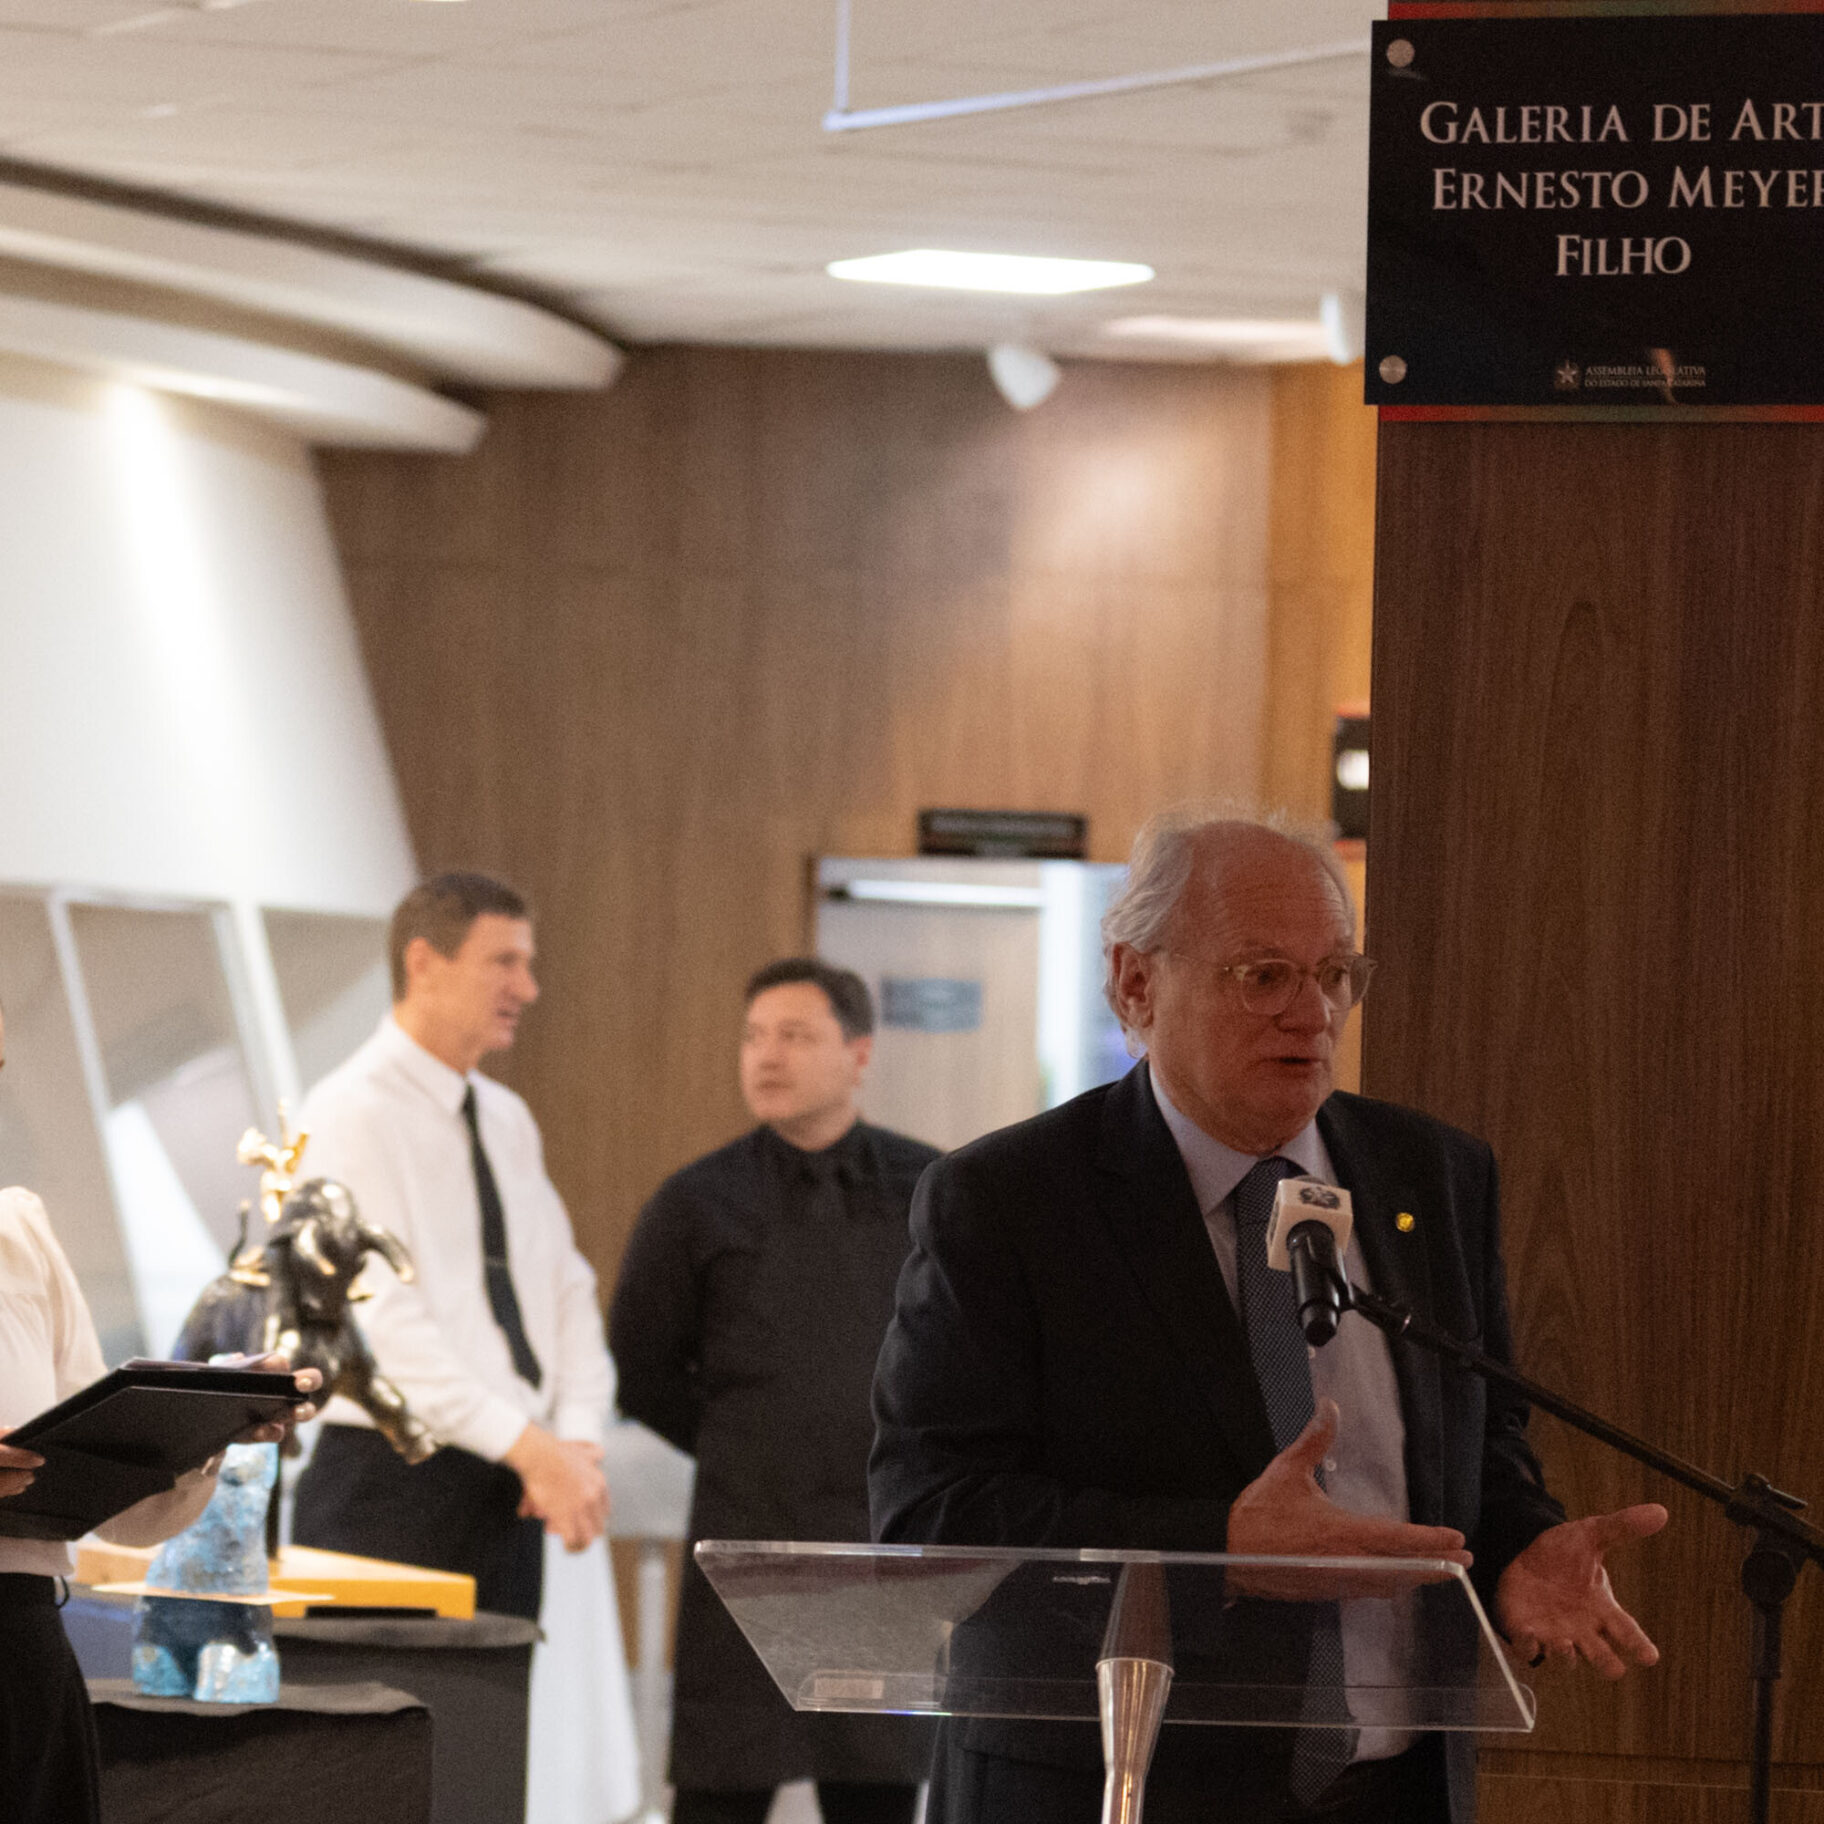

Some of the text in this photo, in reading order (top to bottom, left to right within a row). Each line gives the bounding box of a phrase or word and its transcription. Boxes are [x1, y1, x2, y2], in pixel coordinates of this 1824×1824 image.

[1421, 101, 1631, 144] GALERIA
[1652, 104, 1711, 141] DE
[1432, 168, 1648, 210] ERNESTO
[1556, 235, 1692, 276] FILHO
